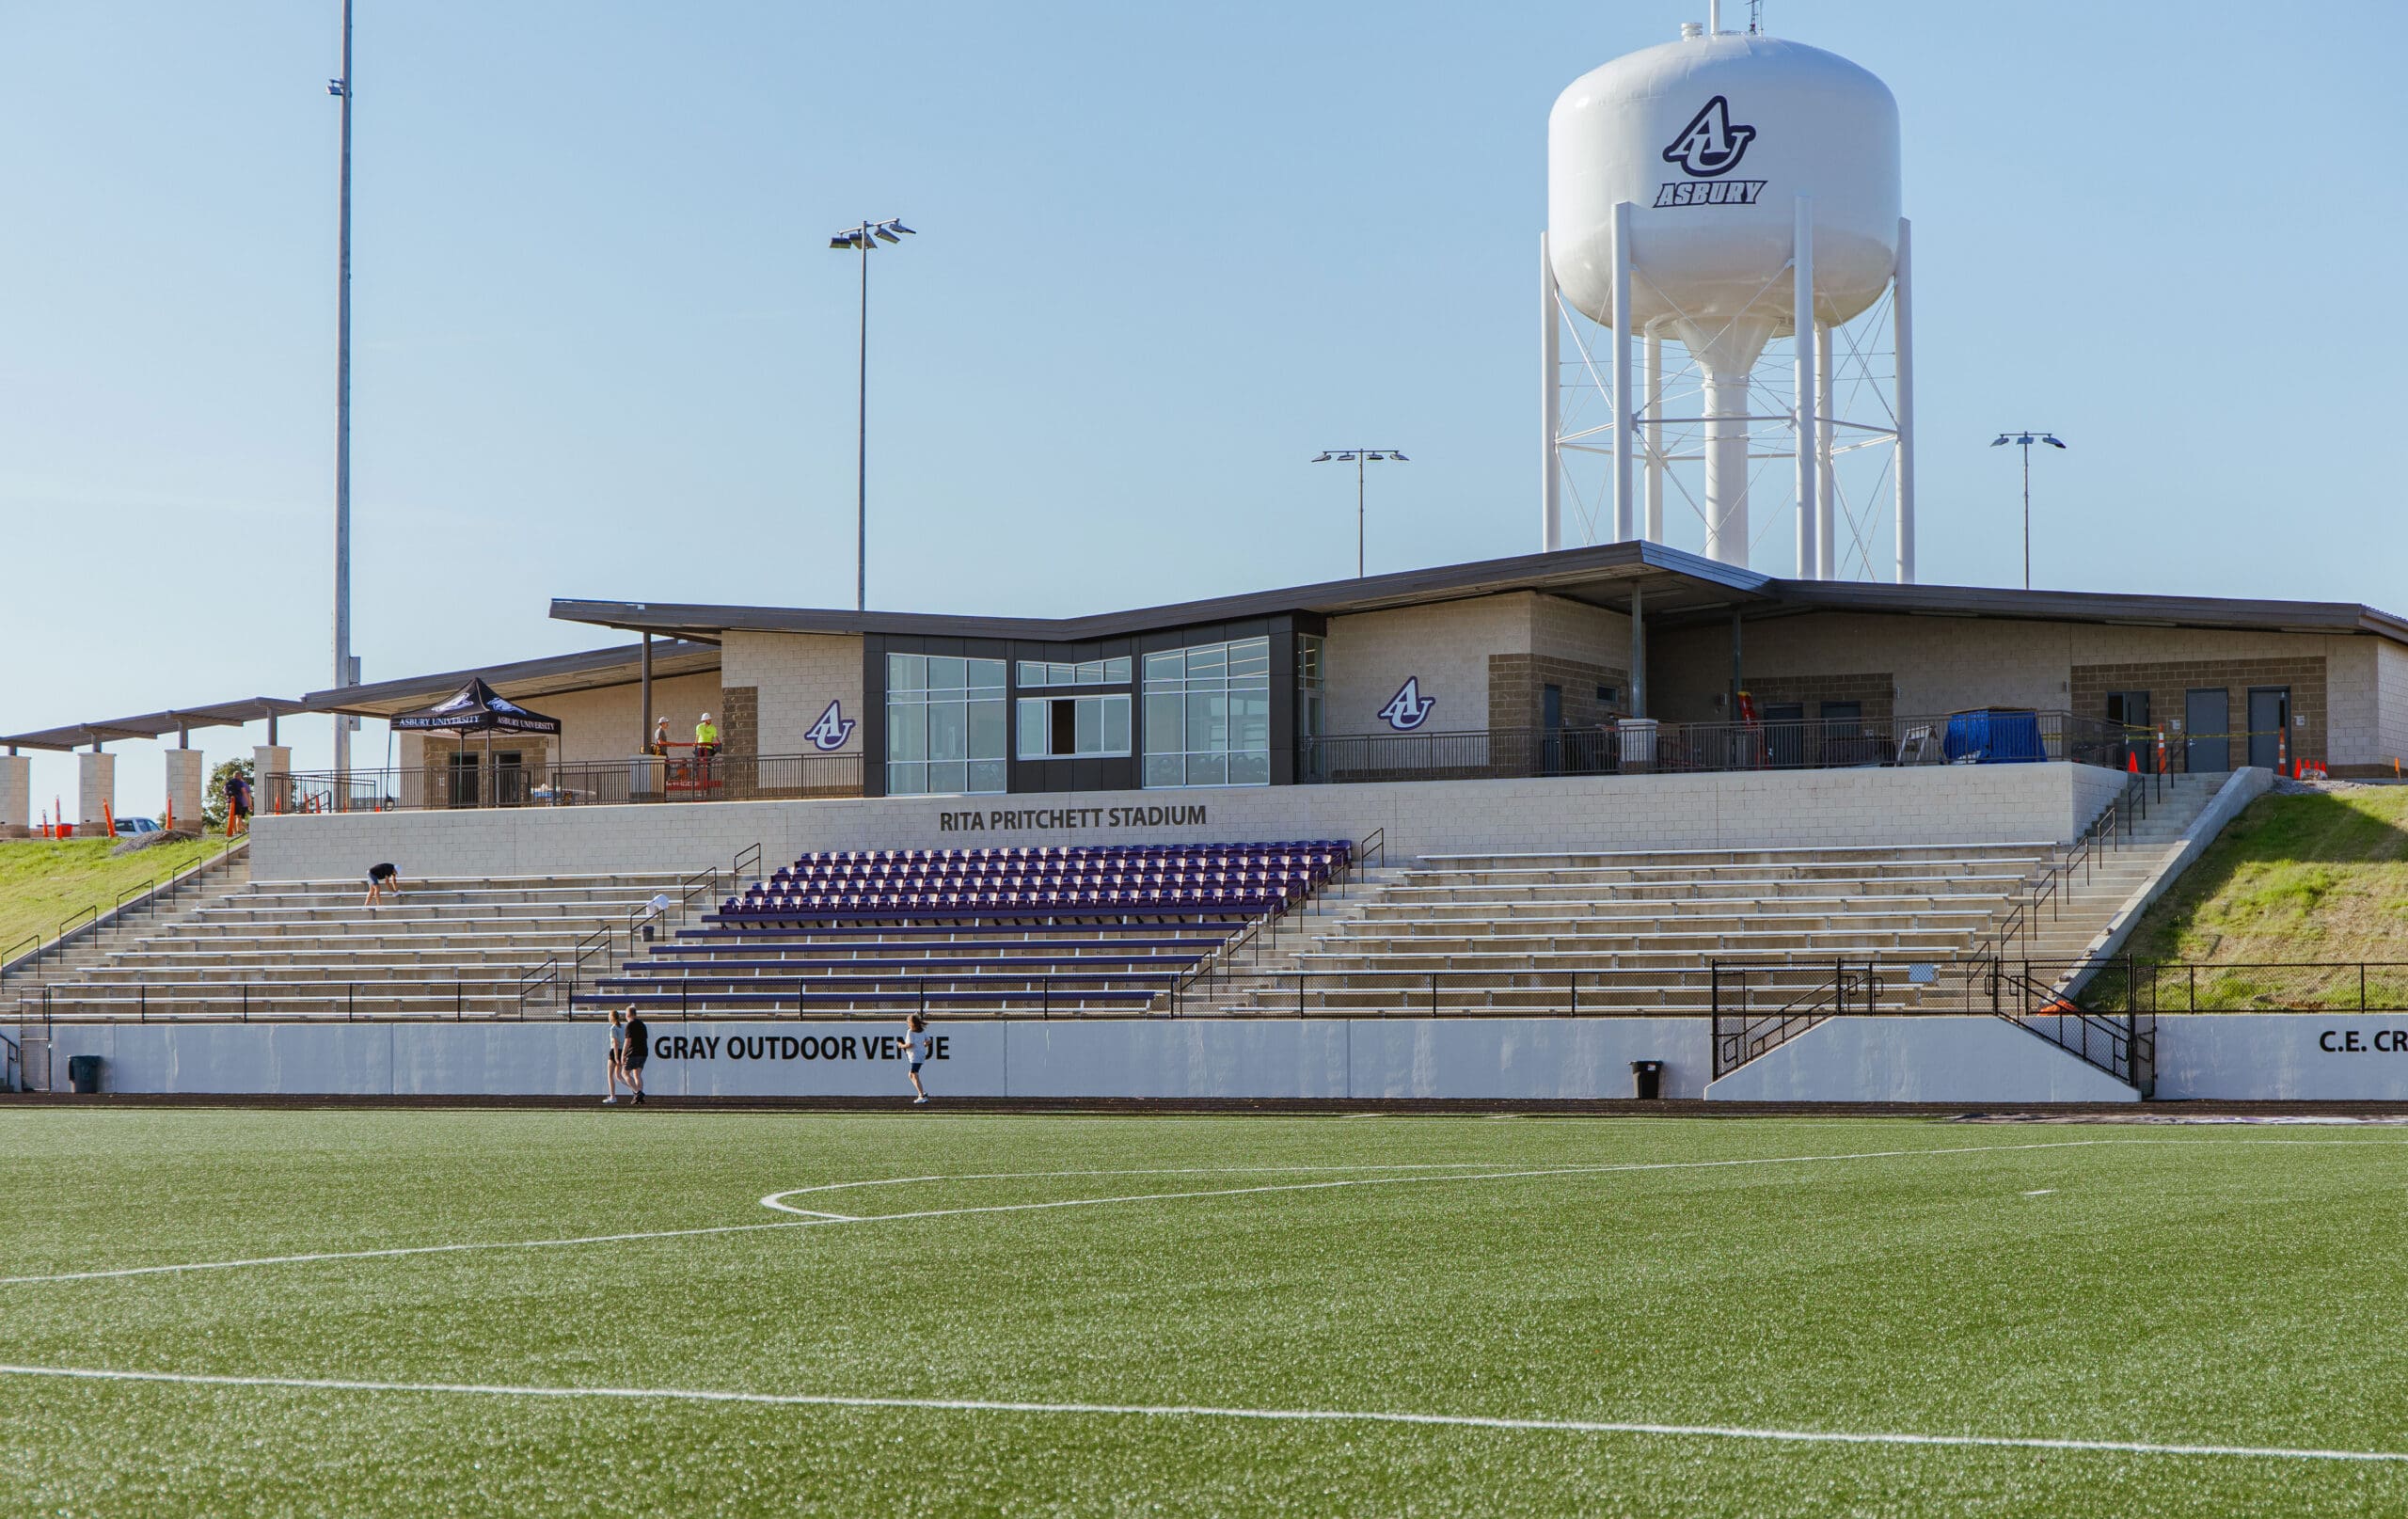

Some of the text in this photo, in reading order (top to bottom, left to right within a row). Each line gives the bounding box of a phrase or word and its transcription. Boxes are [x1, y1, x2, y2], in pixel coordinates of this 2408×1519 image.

[1662, 95, 1757, 178] AU
[1653, 180, 1768, 208] ASBURY
[1377, 675, 1436, 731] AU
[399, 715, 480, 726] ASBURY UNIVERSITY
[497, 716, 554, 730] ASBURY UNIVERSITY
[804, 699, 856, 752] AU
[940, 805, 1207, 831] RITA PRITCHETT STADIUM
[654, 1036, 721, 1060] GRAY
[726, 1036, 858, 1060] OUTDOOR
[2319, 1030, 2408, 1052] C.E. CR
